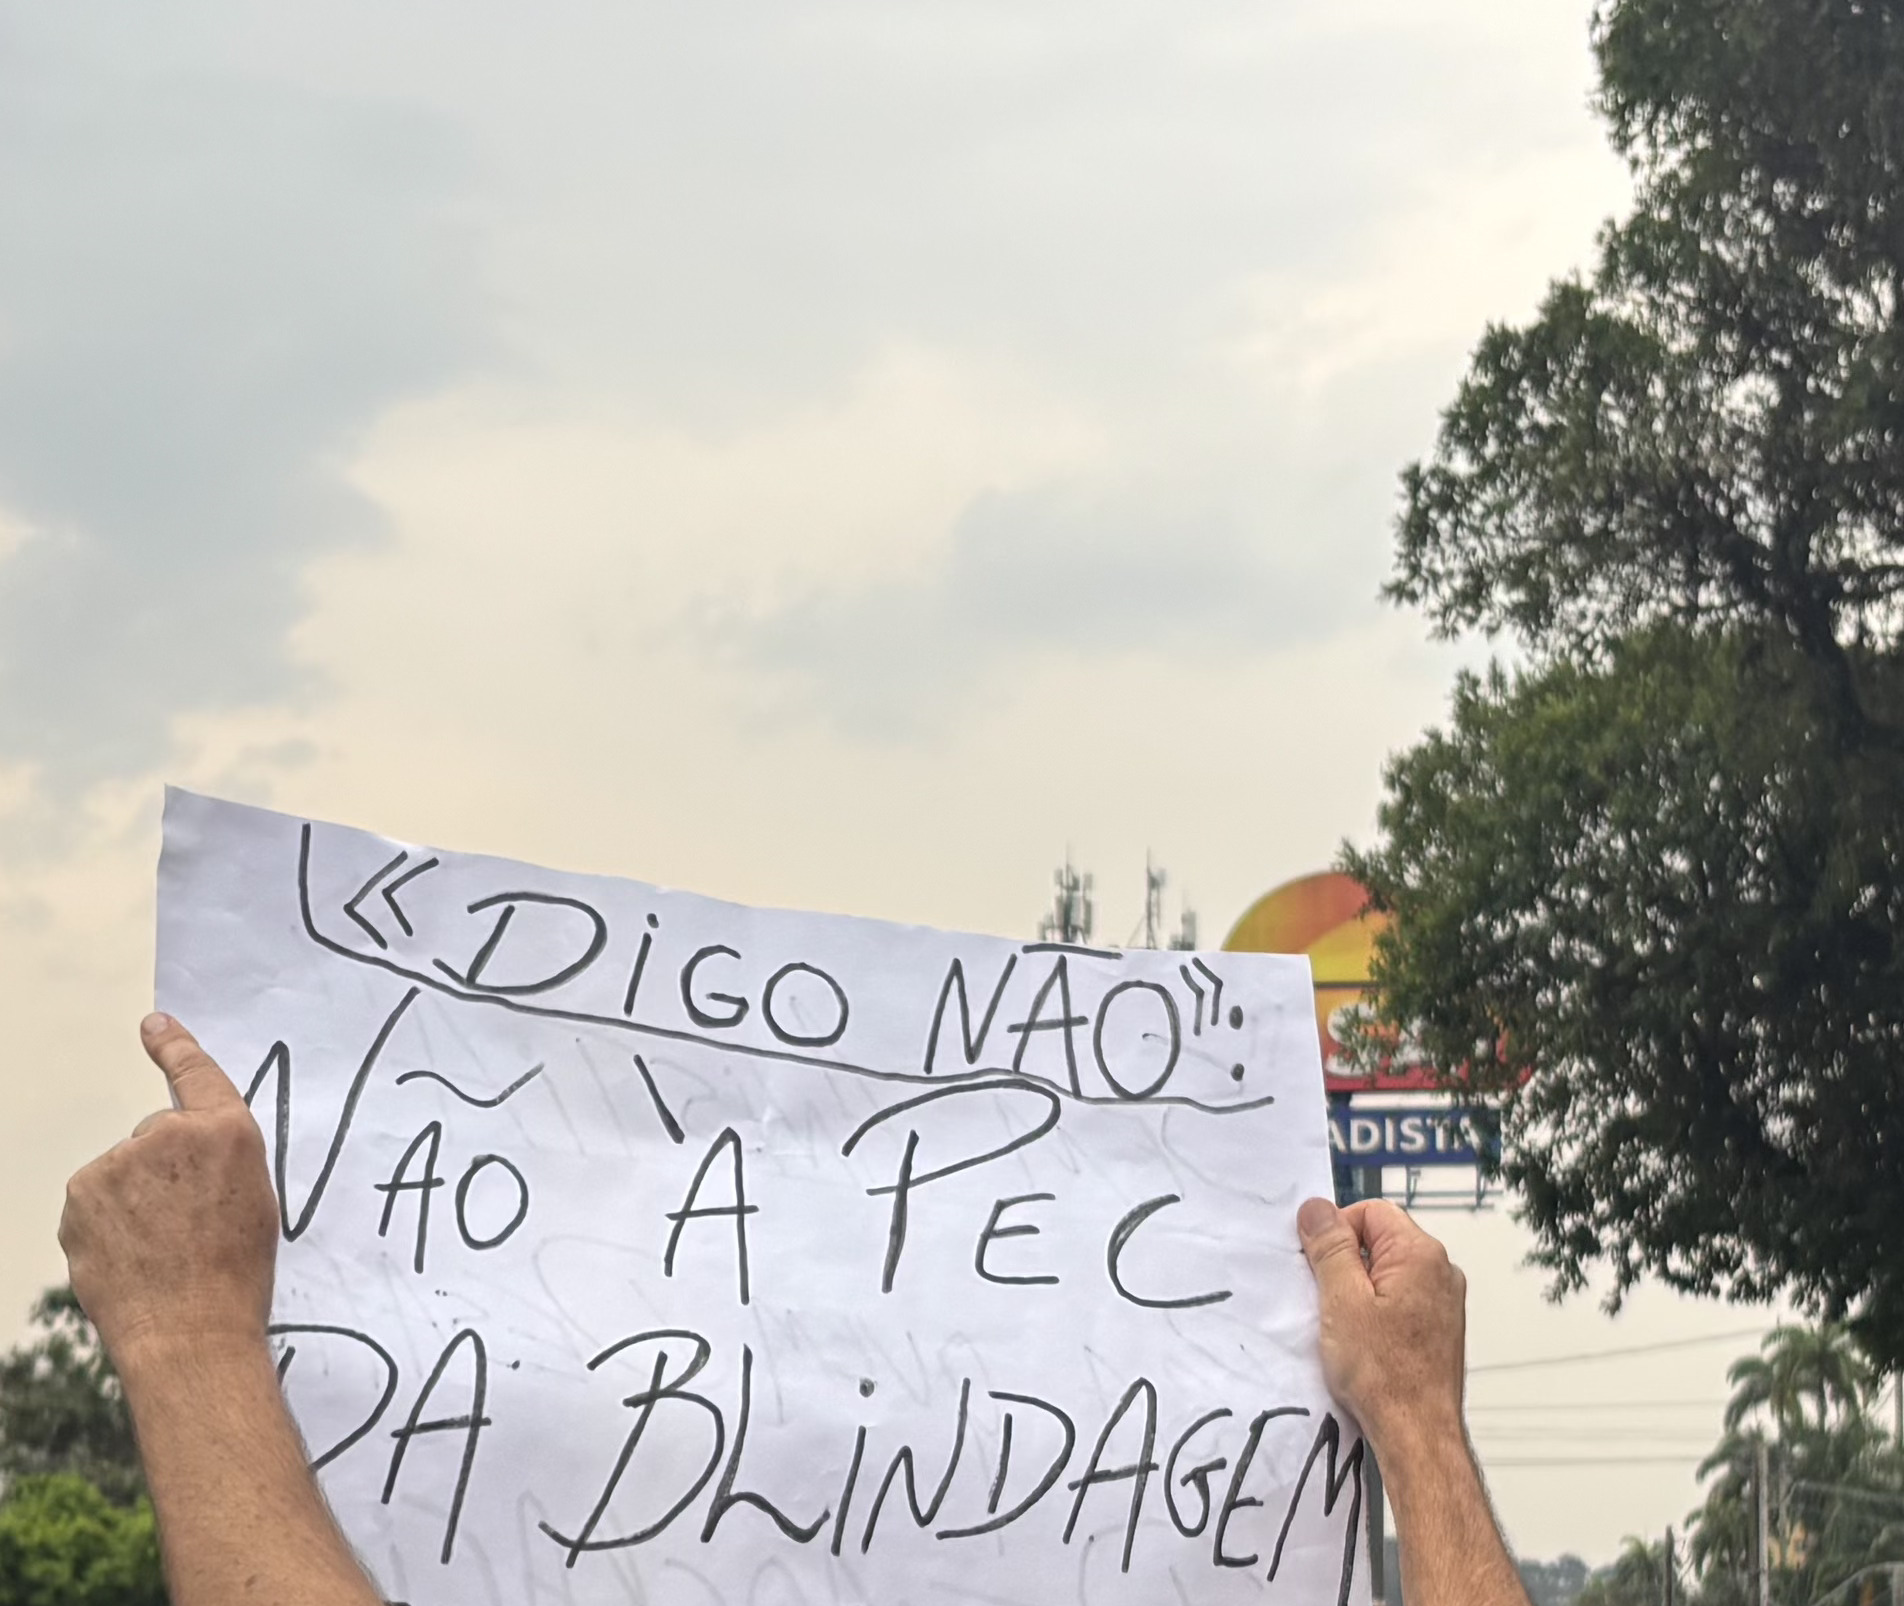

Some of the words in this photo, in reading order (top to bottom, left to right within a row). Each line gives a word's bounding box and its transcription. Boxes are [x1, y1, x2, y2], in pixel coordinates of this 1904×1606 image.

[239, 986, 546, 1274] NÃO
[841, 1080, 1234, 1310] PEC
[268, 1322, 492, 1565] DA
